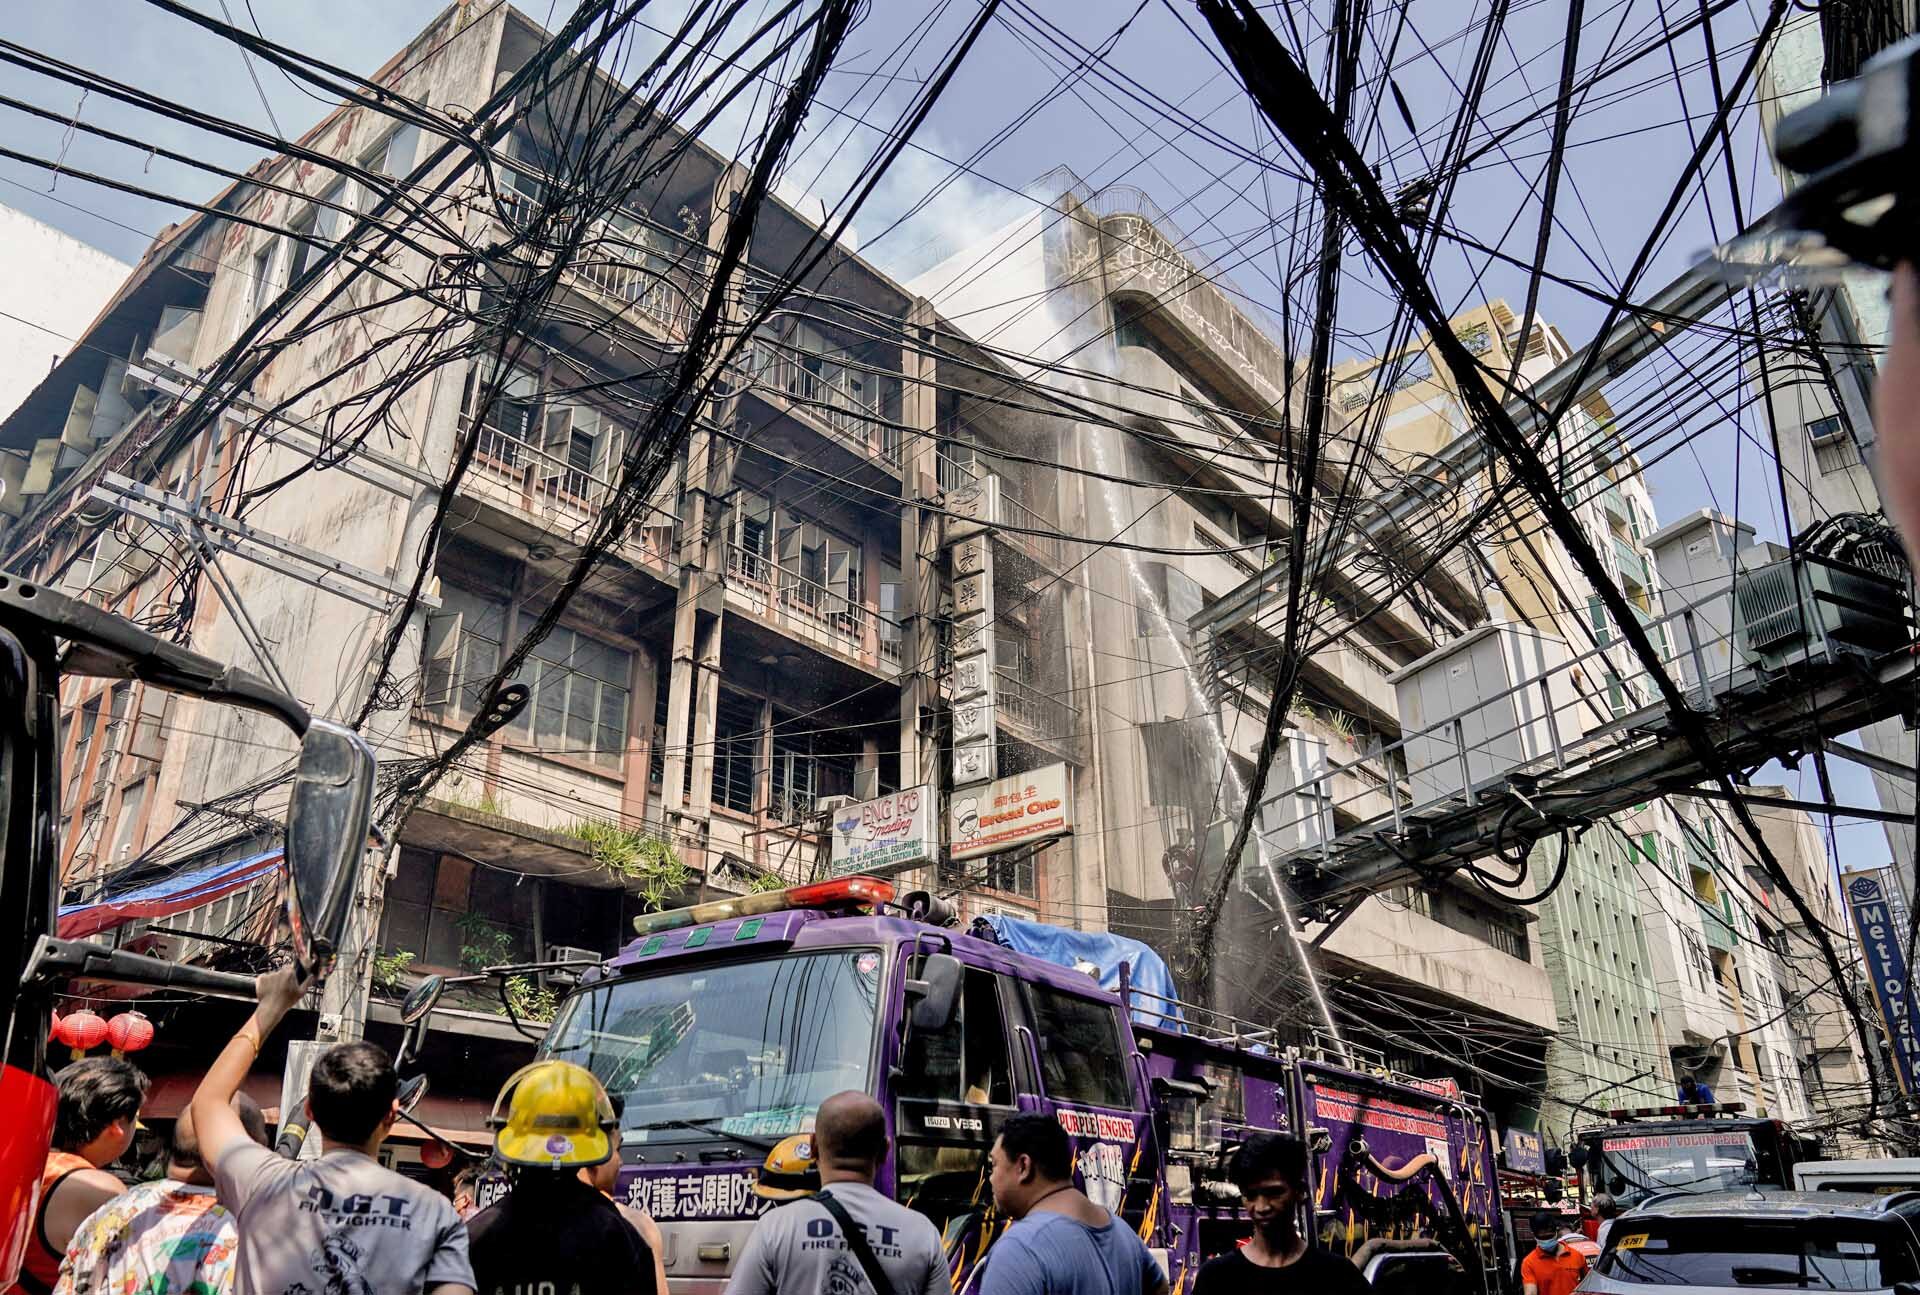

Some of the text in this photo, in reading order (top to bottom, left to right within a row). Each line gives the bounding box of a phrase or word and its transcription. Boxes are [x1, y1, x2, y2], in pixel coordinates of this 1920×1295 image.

[862, 800, 892, 826] ENG
[979, 798, 1061, 828] Bread One
[833, 855, 855, 867] MEDICAL
[863, 848, 888, 861] HOSPITAL
[890, 838, 922, 855] EQUIPMENT
[871, 851, 912, 868] REHABILITATION
[1058, 1111, 1135, 1142] PURPLE ENGINE
[1603, 1134, 1747, 1151] CHINATOWN VOLUNTEER
[628, 1173, 777, 1219] 救護志願防
[335, 1216, 411, 1230] FIGHTER
[802, 1240, 835, 1251] FIRE
